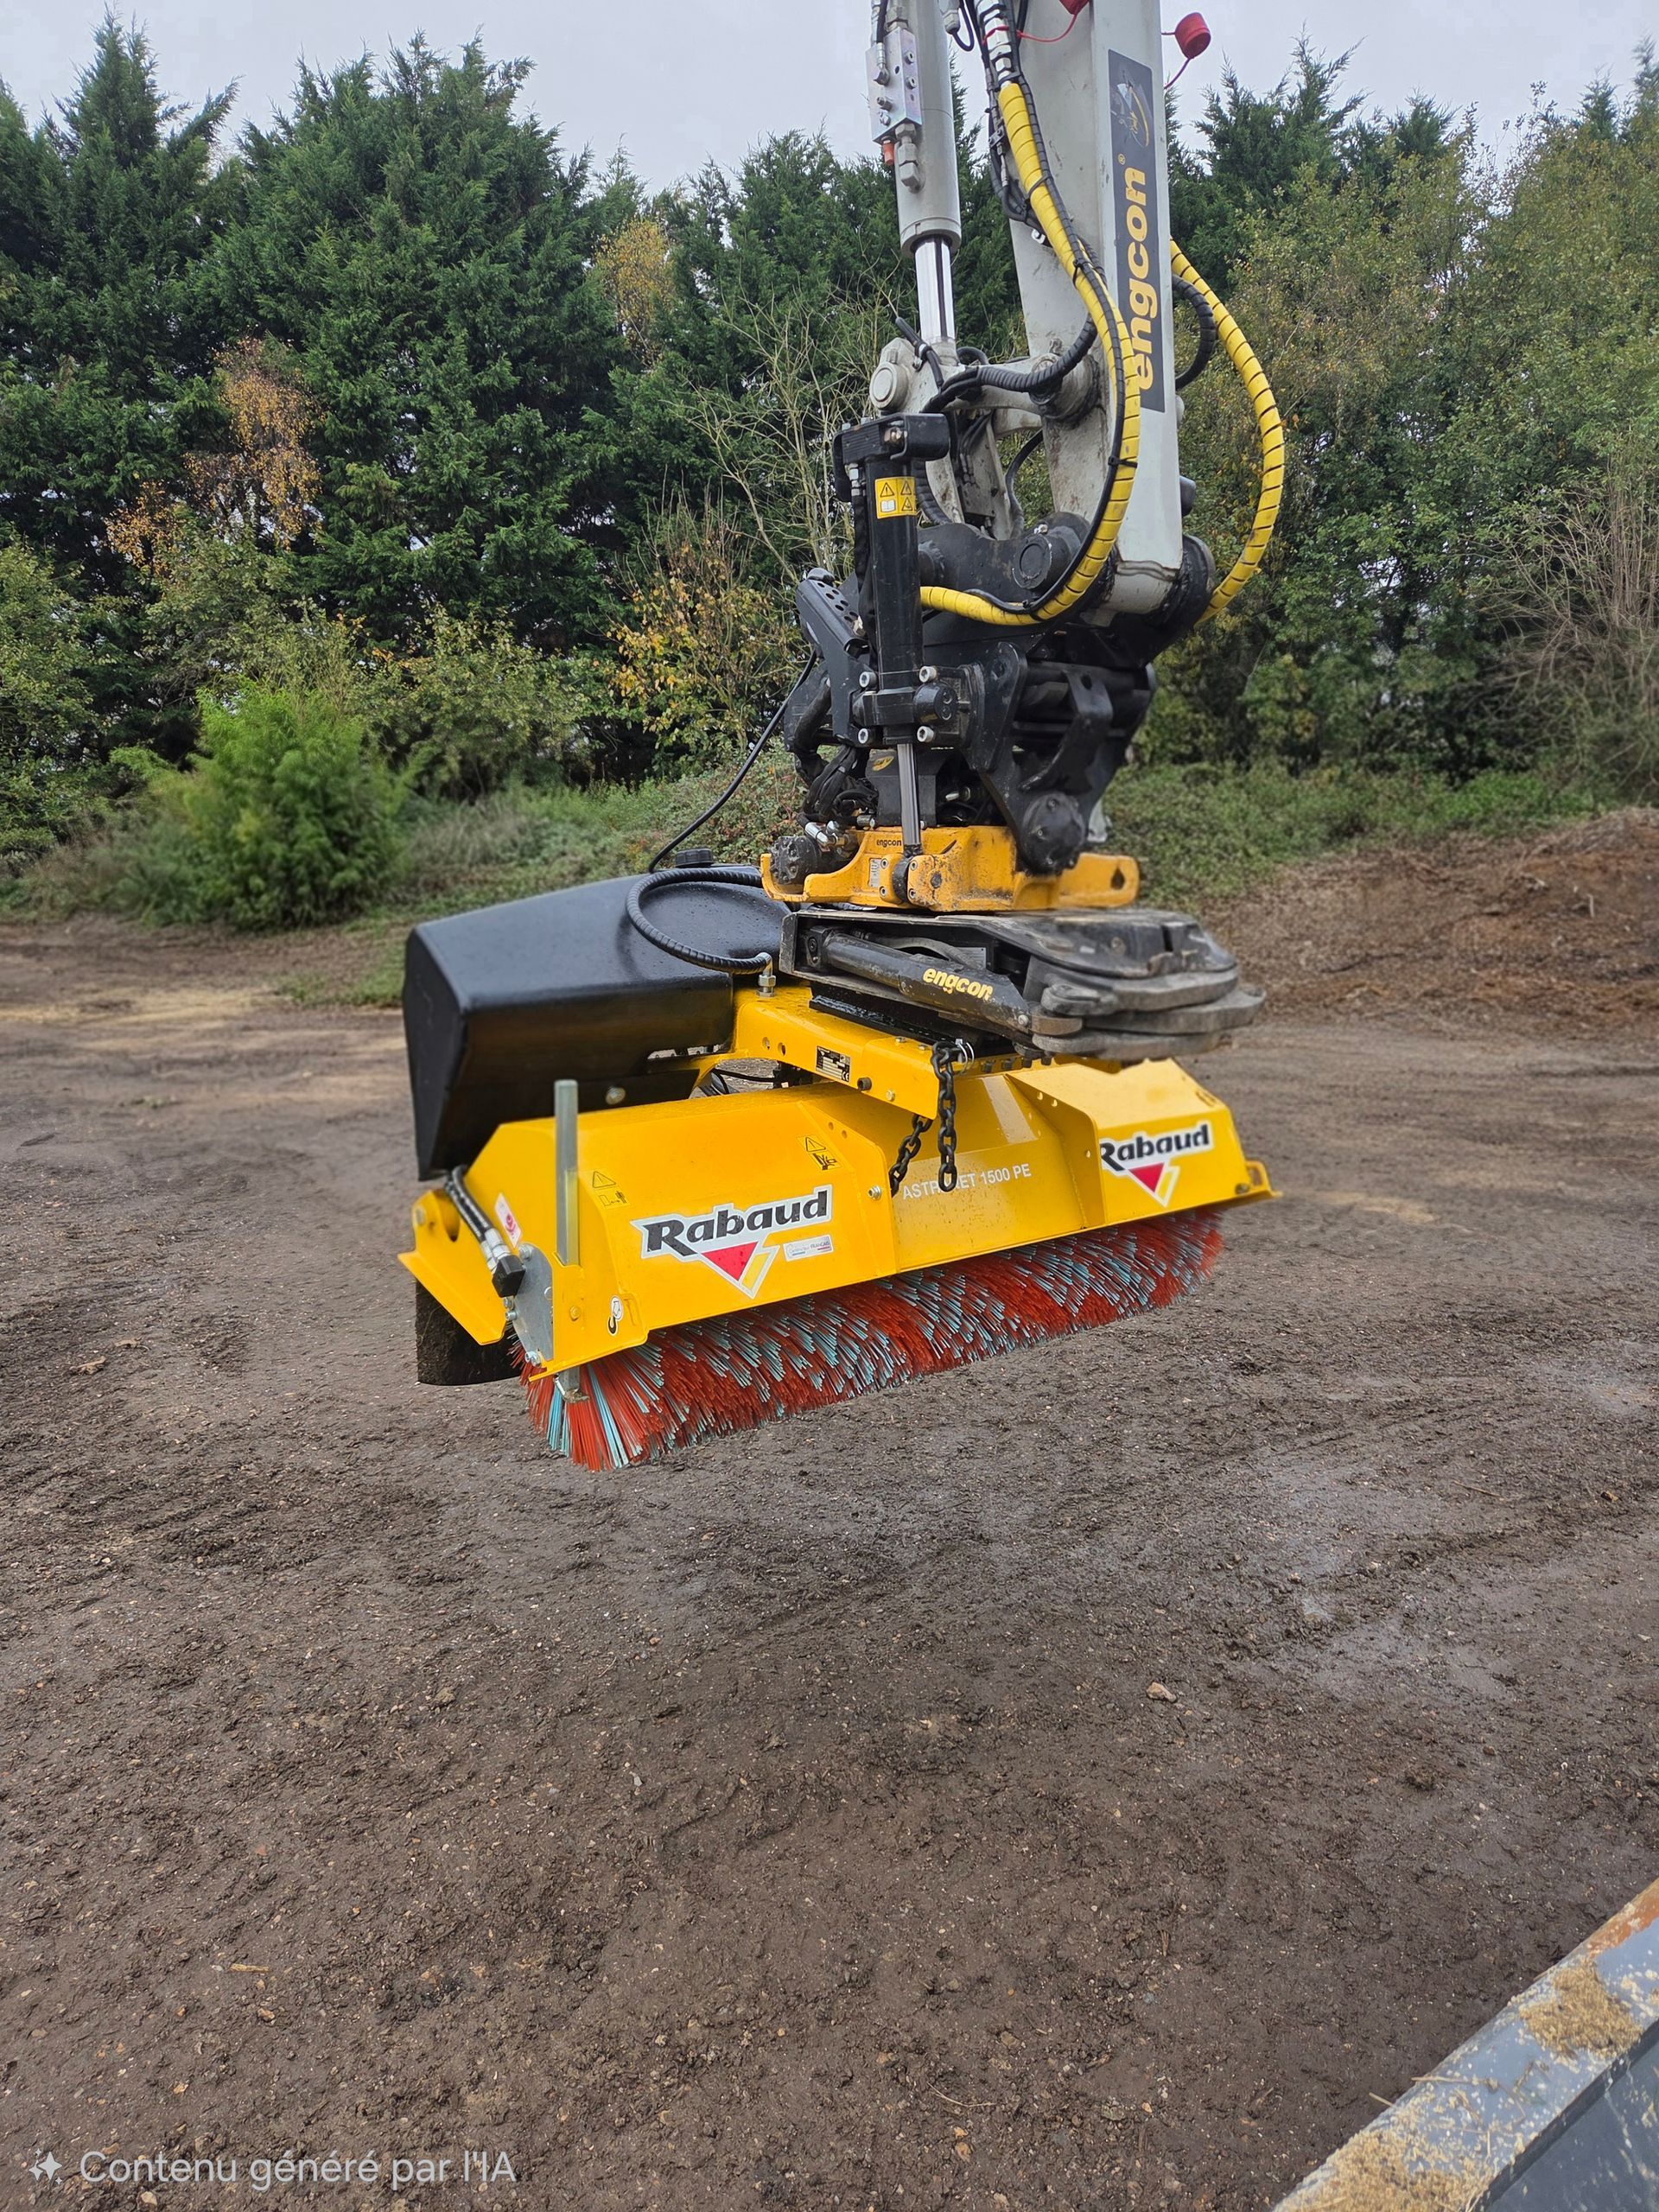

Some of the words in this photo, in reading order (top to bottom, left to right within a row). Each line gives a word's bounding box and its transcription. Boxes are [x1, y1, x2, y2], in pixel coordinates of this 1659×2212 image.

[1124, 167, 1158, 391] engcon
[922, 968, 994, 1001] engcon
[1099, 1123, 1210, 1172] Rabaud
[902, 1173, 976, 1200] ASTRET
[981, 1167, 1011, 1185] 1500
[1013, 1163, 1032, 1179] PE
[642, 1190, 829, 1256] Rabaud
